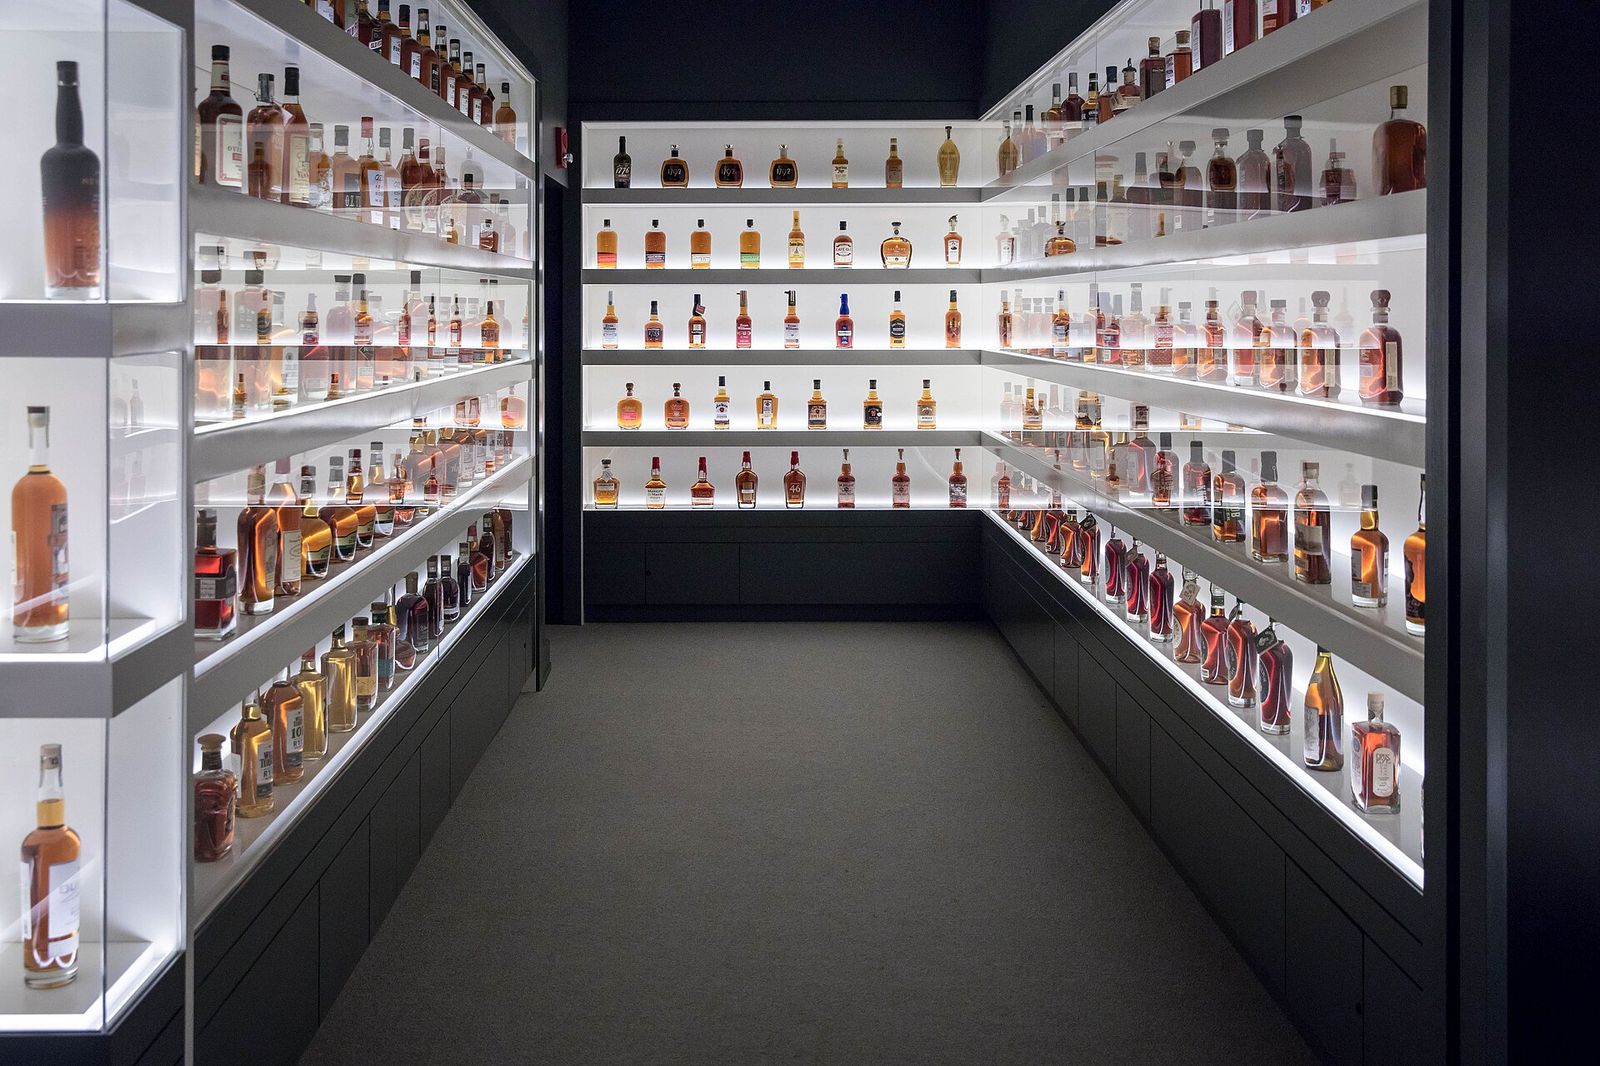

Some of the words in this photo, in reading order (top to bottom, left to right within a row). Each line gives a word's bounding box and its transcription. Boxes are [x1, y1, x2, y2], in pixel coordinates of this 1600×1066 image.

[615, 166, 630, 175] 1776
[668, 168, 682, 177] 1792
[721, 168, 735, 177] 1792
[776, 167, 790, 176] 1792
[789, 485, 801, 493] 46
